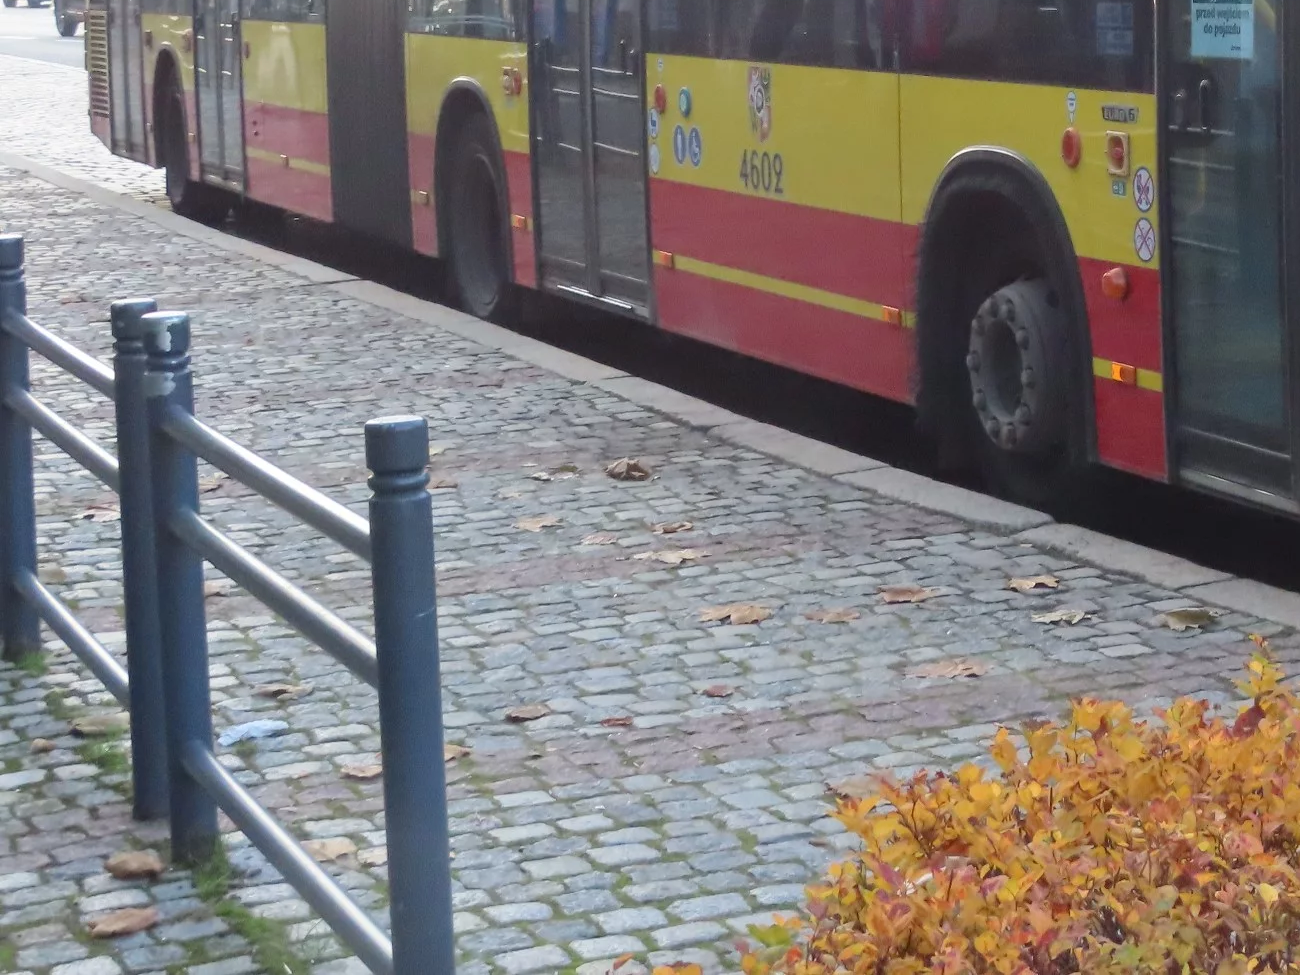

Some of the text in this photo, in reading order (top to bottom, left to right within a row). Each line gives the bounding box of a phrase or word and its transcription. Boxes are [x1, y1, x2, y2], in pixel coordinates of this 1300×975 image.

[1195, 7, 1216, 22] przed
[1203, 23, 1213, 34] do
[739, 149, 784, 194] 4602
